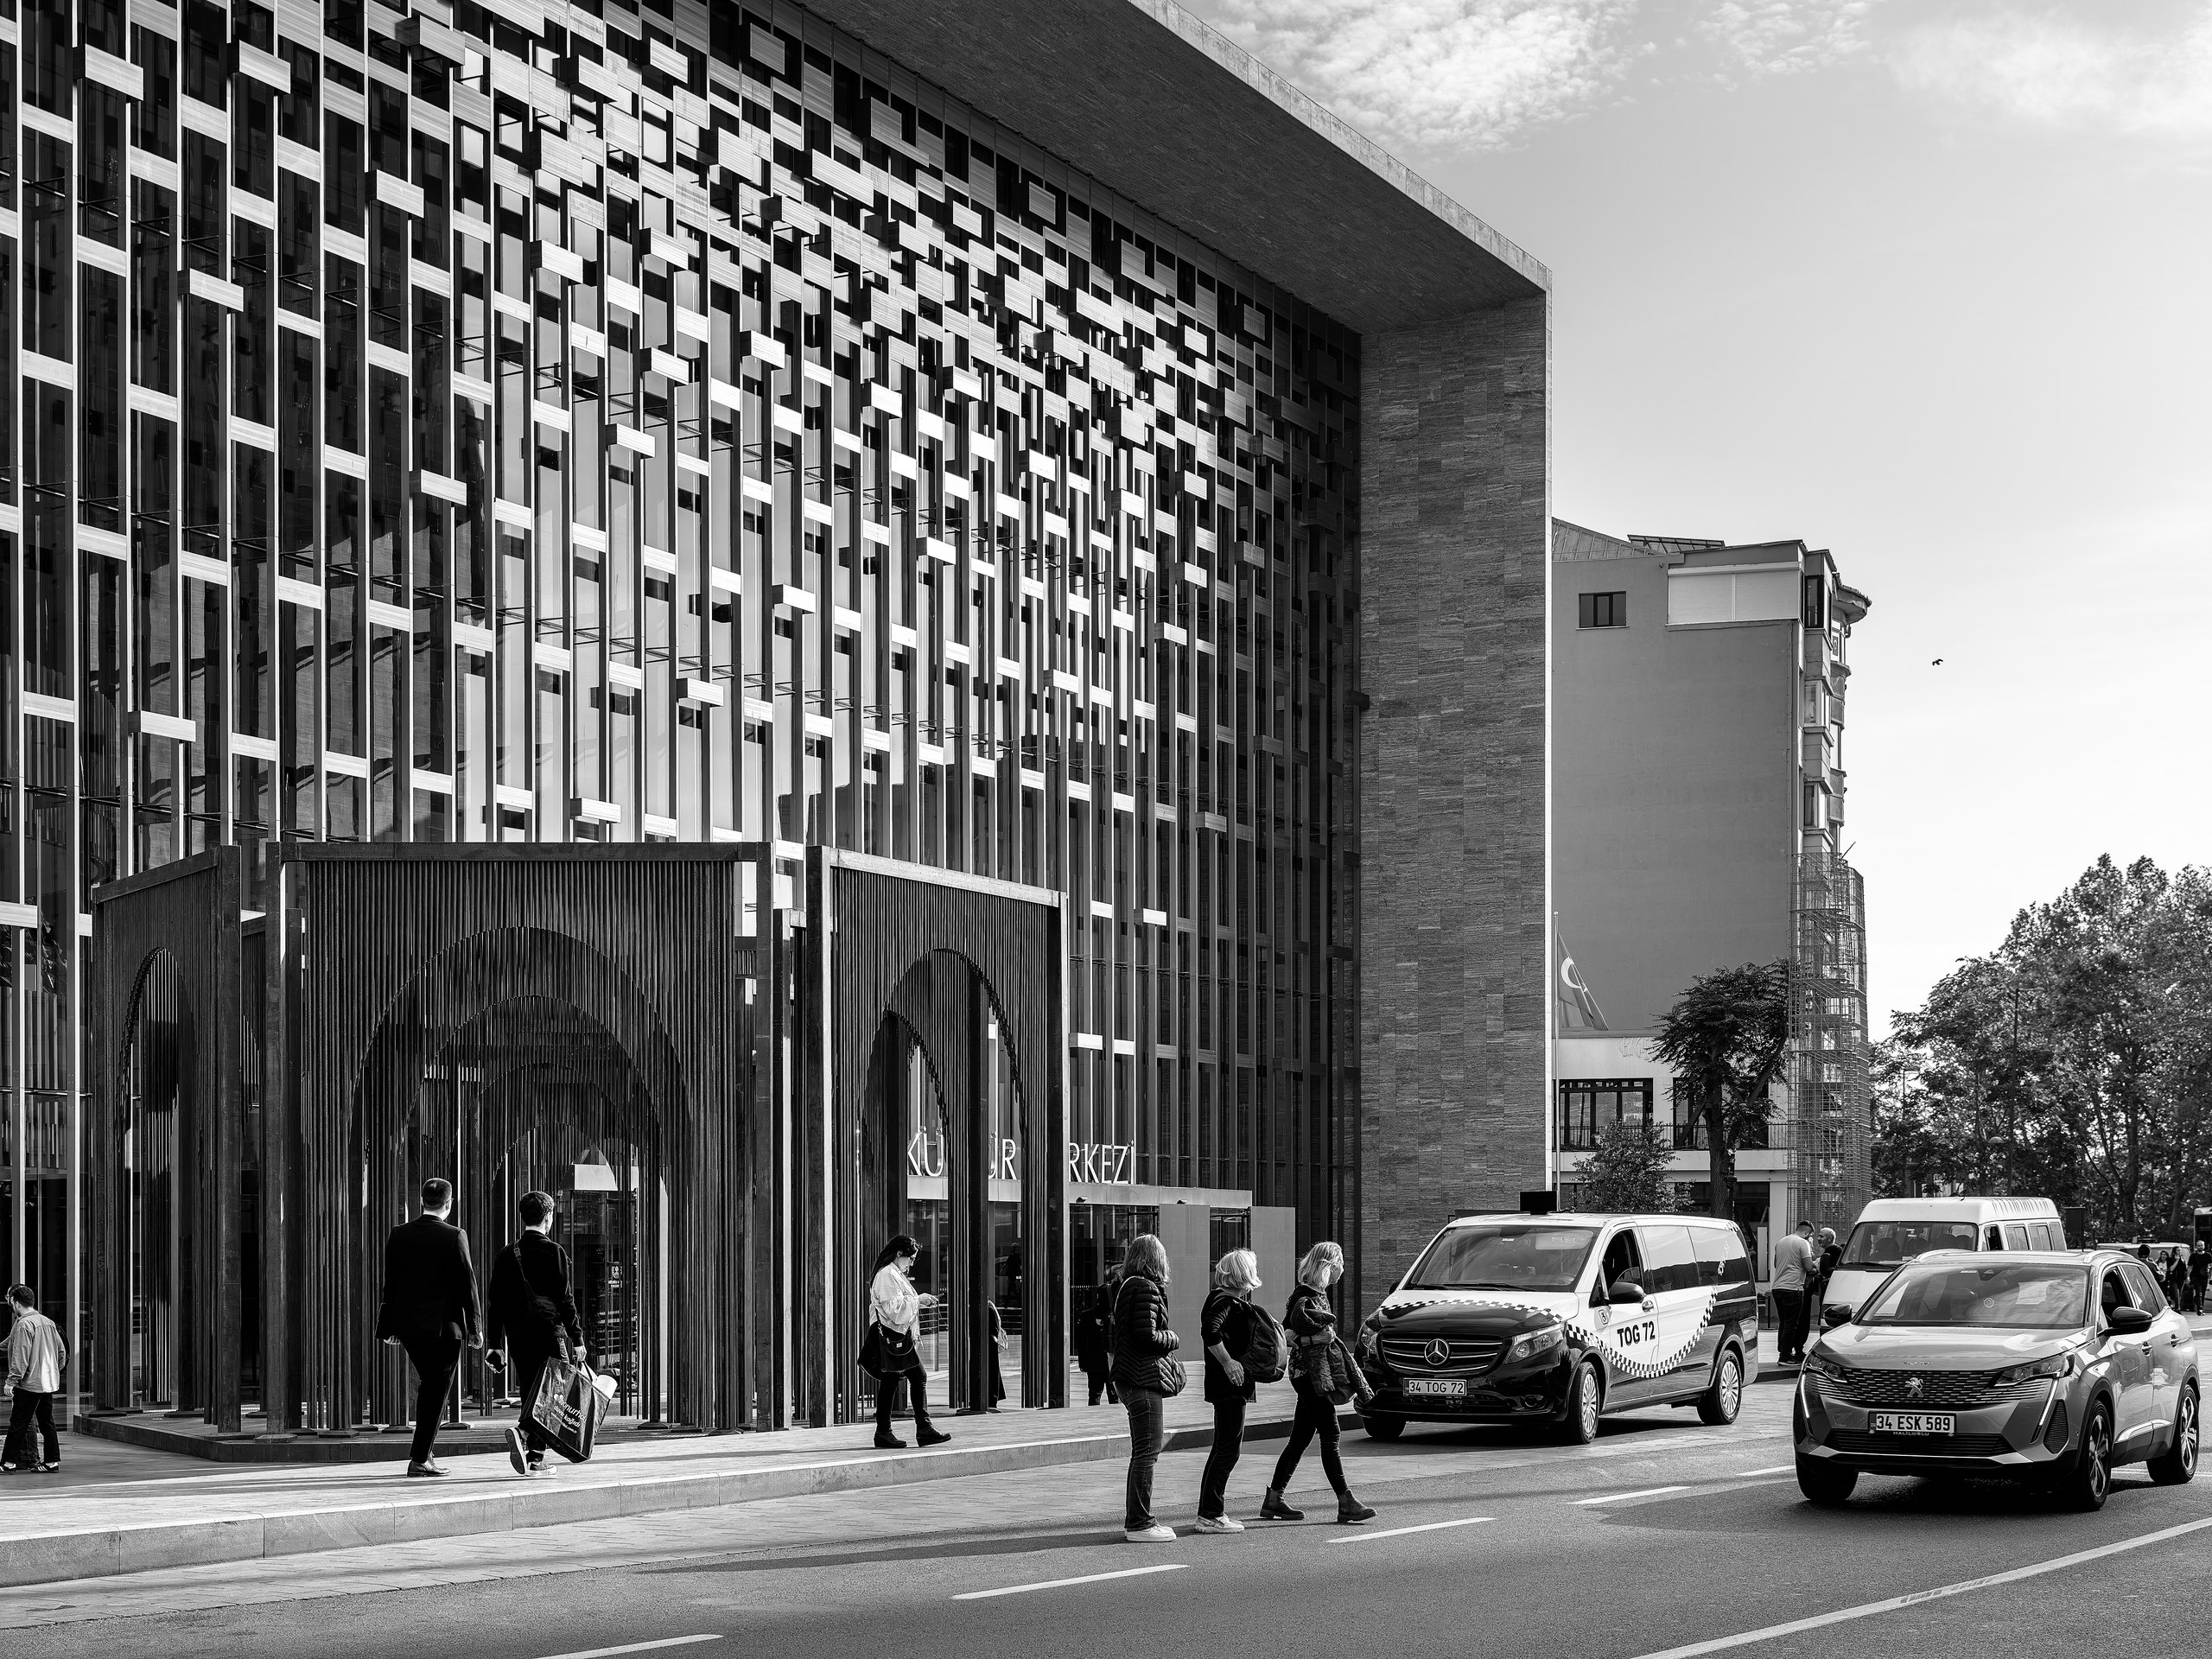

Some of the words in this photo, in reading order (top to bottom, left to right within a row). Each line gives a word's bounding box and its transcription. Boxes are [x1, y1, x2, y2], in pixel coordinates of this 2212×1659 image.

[1069, 1139, 1135, 1185] RKEZİ
[1617, 1325, 1640, 1348] TOG
[1643, 1321, 1656, 1342] 72
[1409, 1382, 1421, 1392] 34
[1426, 1382, 1446, 1393] TOG
[1452, 1382, 1464, 1393] 72
[1877, 1415, 1892, 1429] 34
[1897, 1416, 1922, 1430] ESK
[1926, 1417, 1950, 1431] 589
